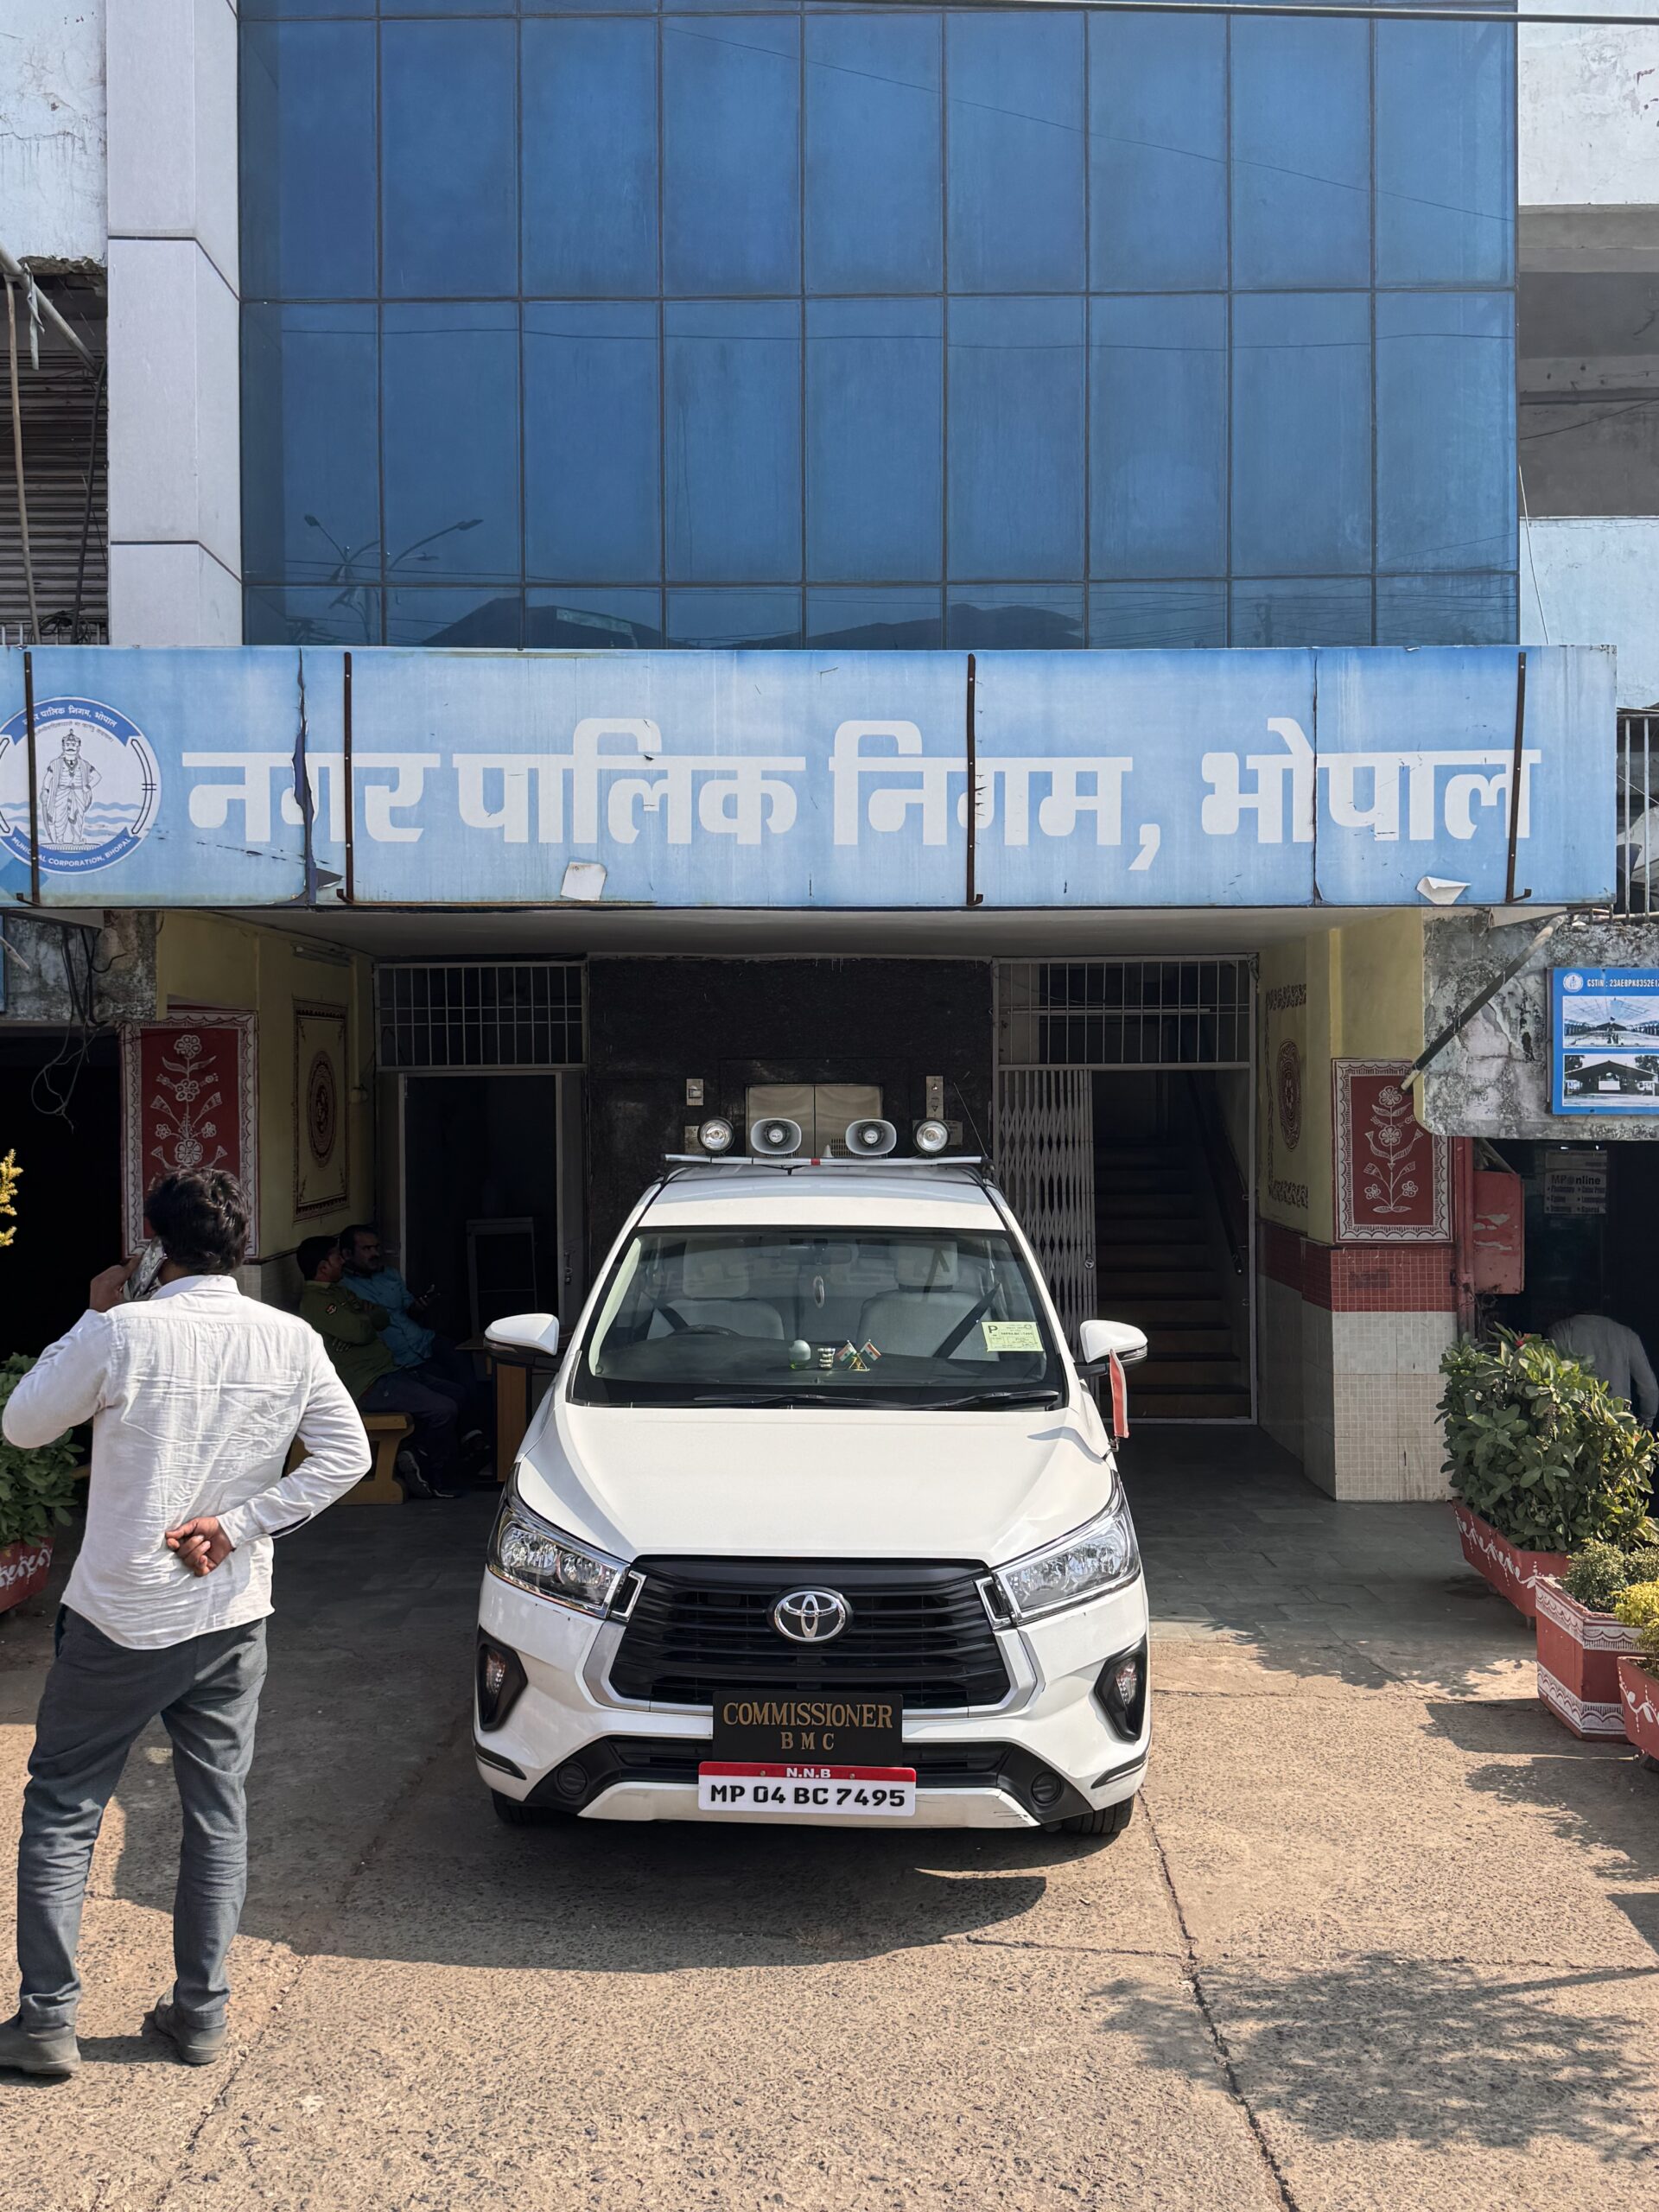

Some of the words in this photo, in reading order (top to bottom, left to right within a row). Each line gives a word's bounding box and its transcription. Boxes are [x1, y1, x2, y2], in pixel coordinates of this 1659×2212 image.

[182, 753, 441, 842] नगर
[453, 718, 806, 845] पालिक
[829, 720, 1161, 871] निगम,
[1201, 717, 1542, 844] भोपाल
[11, 836, 47, 861] MUNICAL
[105, 838, 131, 859] BHOPAL
[1586, 979, 1605, 988] GSTIN
[988, 1325, 998, 1334] P
[723, 1700, 893, 1729] COMMISSIONER
[785, 1767, 831, 1779] N.N.B
[710, 1784, 745, 1802] MP
[753, 1785, 786, 1803] 04
[793, 1787, 829, 1805] BC
[836, 1788, 906, 1807] 7495
